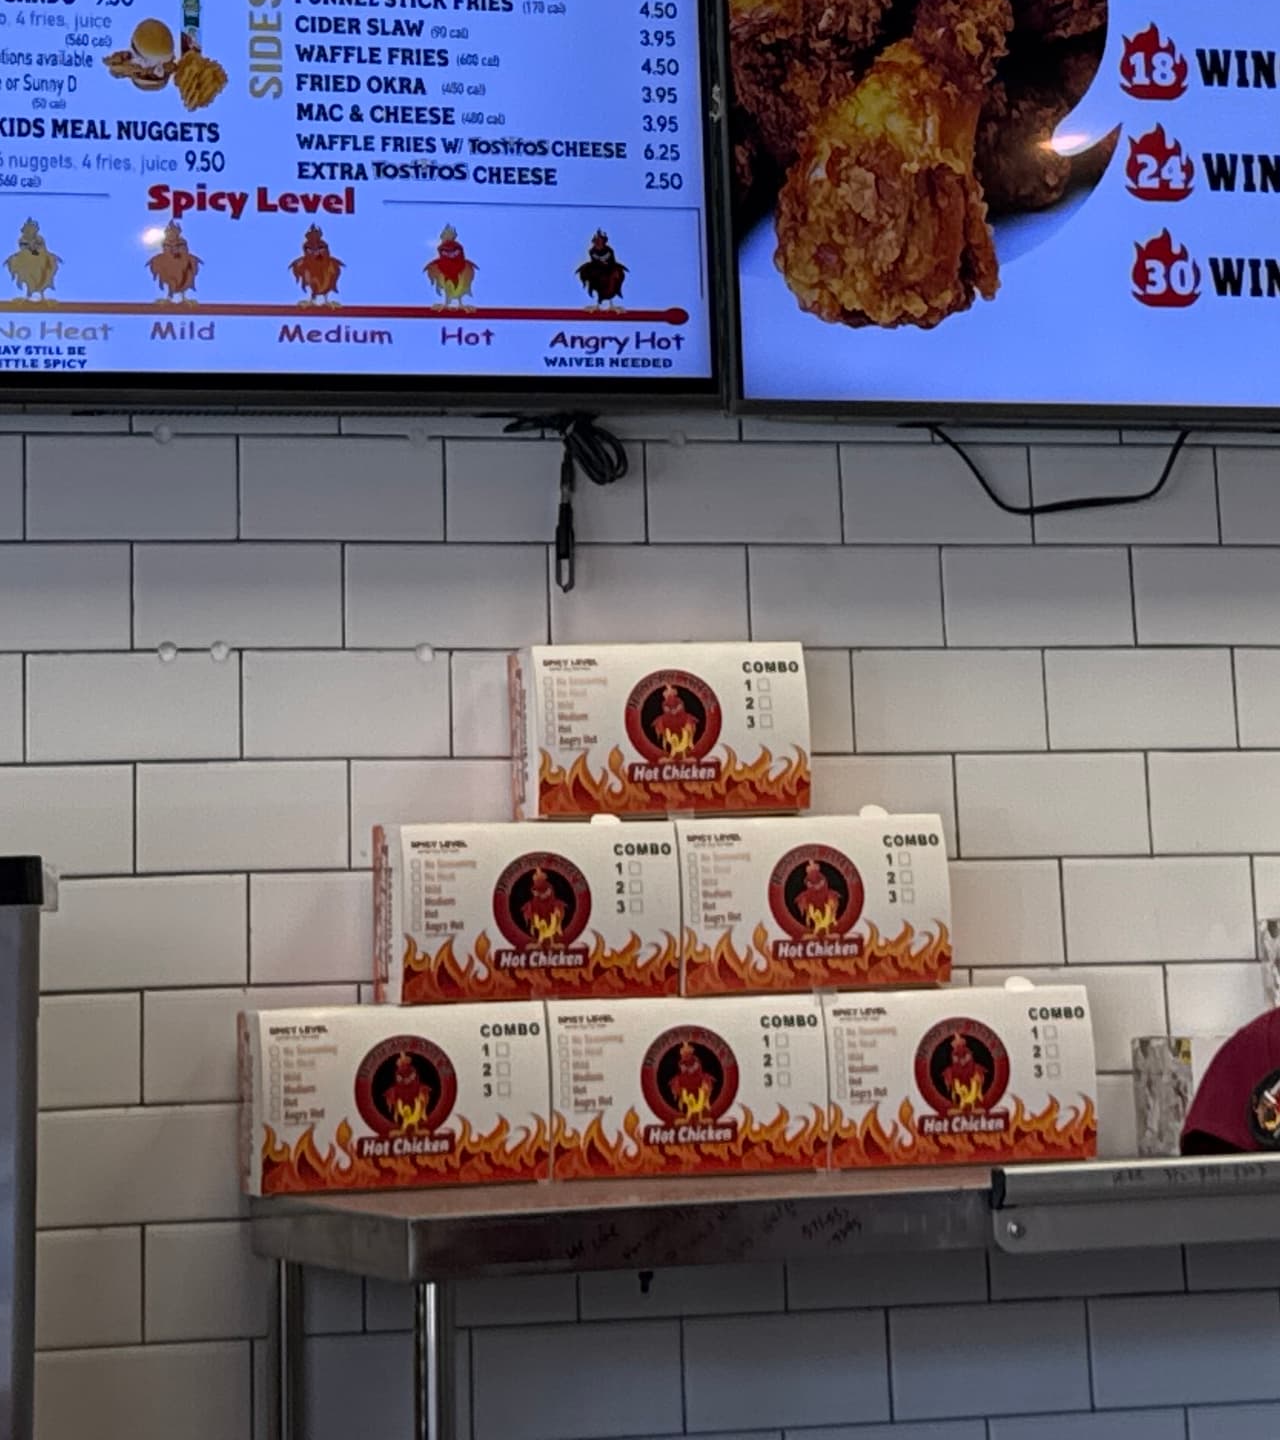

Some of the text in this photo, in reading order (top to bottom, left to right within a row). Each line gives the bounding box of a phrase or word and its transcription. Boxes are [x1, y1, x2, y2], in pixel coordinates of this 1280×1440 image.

[640, 2, 677, 19] 4.50
[1129, 51, 1178, 86] 18
[296, 74, 677, 104] FRIED OKRA 3.95
[52, 119, 111, 139] MEAL
[117, 121, 219, 143] NUGGETS
[185, 150, 225, 172] 9.50
[1136, 154, 1185, 190] 24
[148, 184, 354, 218] Spicy Level
[1145, 259, 1194, 295] 30
[151, 321, 215, 340] Mild
[279, 325, 392, 344] Medium
[442, 327, 494, 345] Hot
[550, 332, 684, 355] Angry Hot
[743, 661, 798, 673] COMBO
[633, 764, 716, 781] Hot Chicken
[480, 1023, 540, 1037] COMBO
[362, 1138, 450, 1156] Hot Chicken
